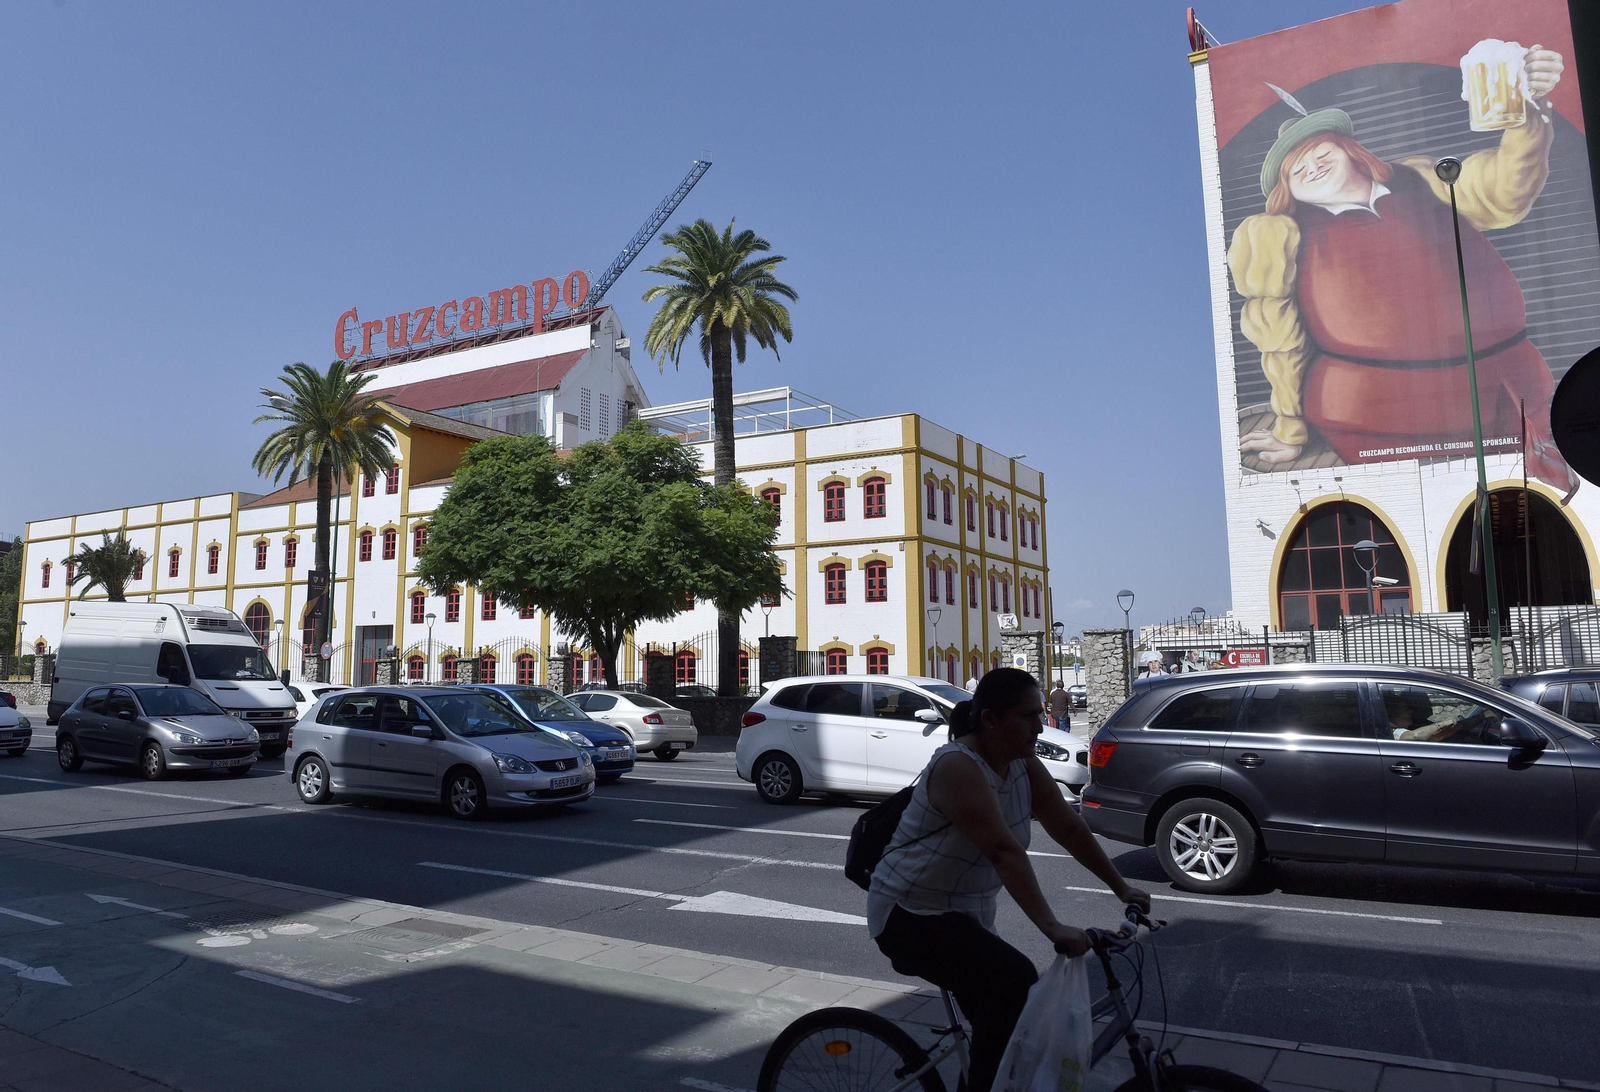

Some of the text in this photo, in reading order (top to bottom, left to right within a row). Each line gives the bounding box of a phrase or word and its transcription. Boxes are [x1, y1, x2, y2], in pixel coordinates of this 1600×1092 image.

[334, 269, 589, 360] Cruzcampo
[1359, 448, 1394, 457] CRUZCAMPO
[1395, 444, 1433, 454] RECOMIENDA
[1443, 440, 1474, 450] CONSUMO
[1482, 437, 1521, 447] SPONSABLE.
